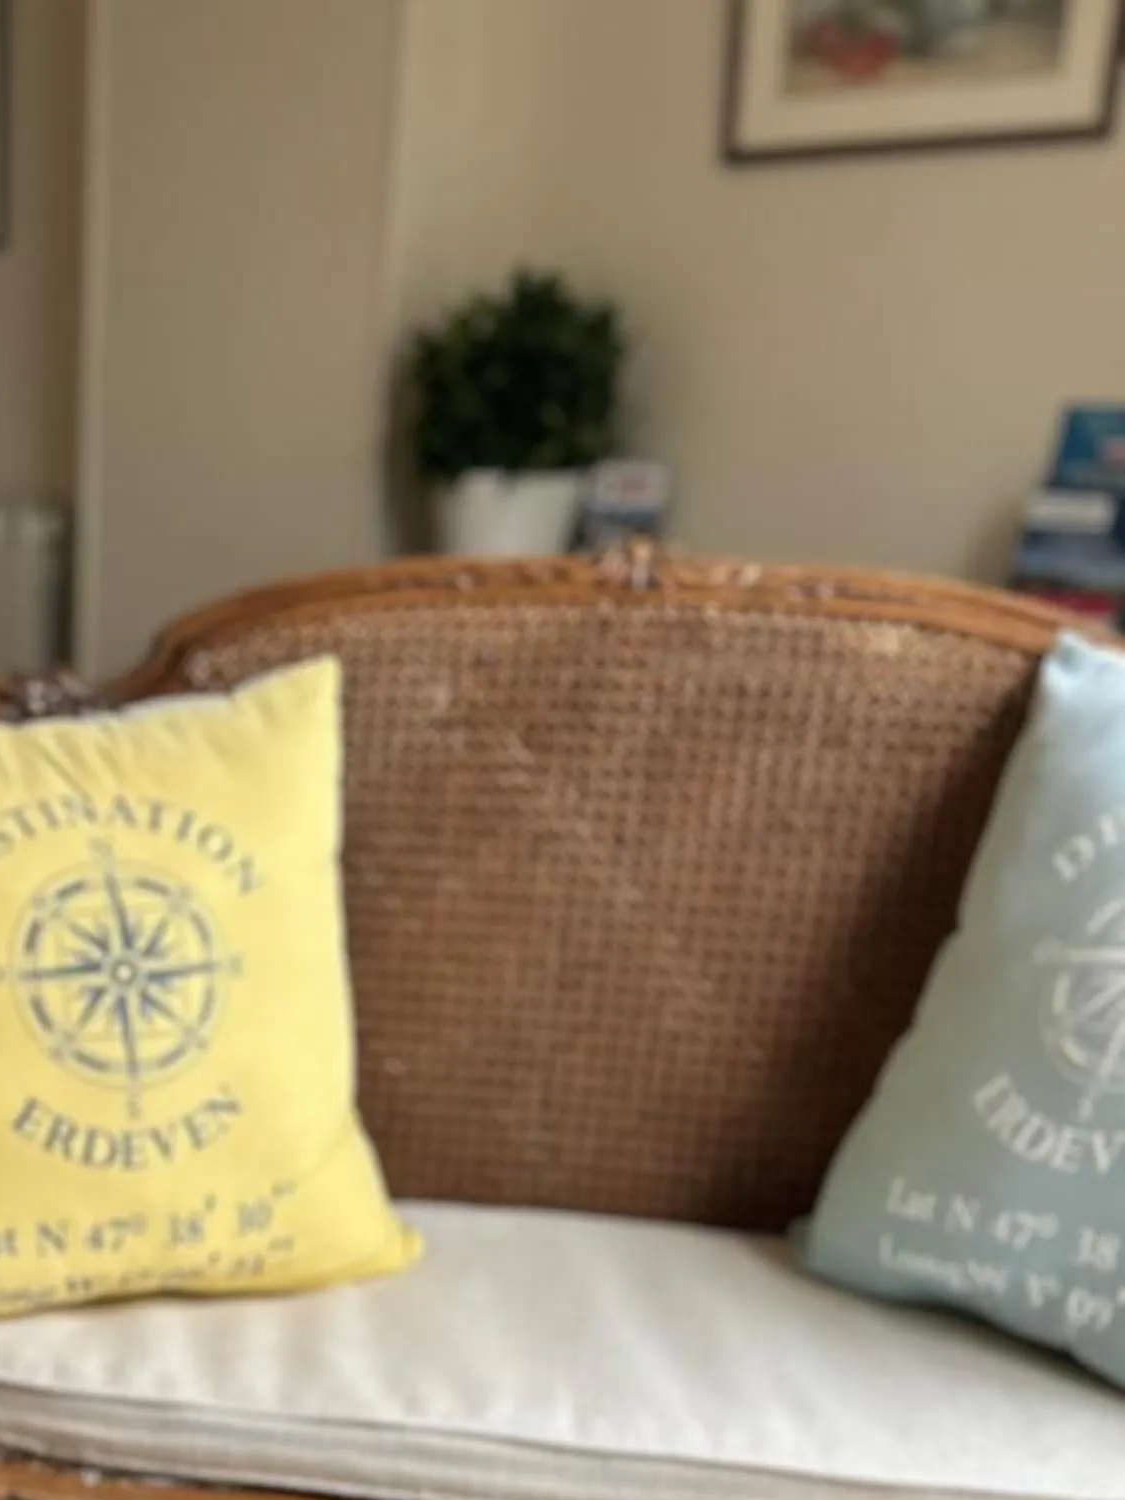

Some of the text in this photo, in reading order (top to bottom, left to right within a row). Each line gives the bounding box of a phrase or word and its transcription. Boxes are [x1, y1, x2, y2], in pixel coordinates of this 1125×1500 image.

[9, 1083, 244, 1171] ERDEVEN
[887, 1176, 938, 1222] Lat
[35, 1216, 70, 1257] N
